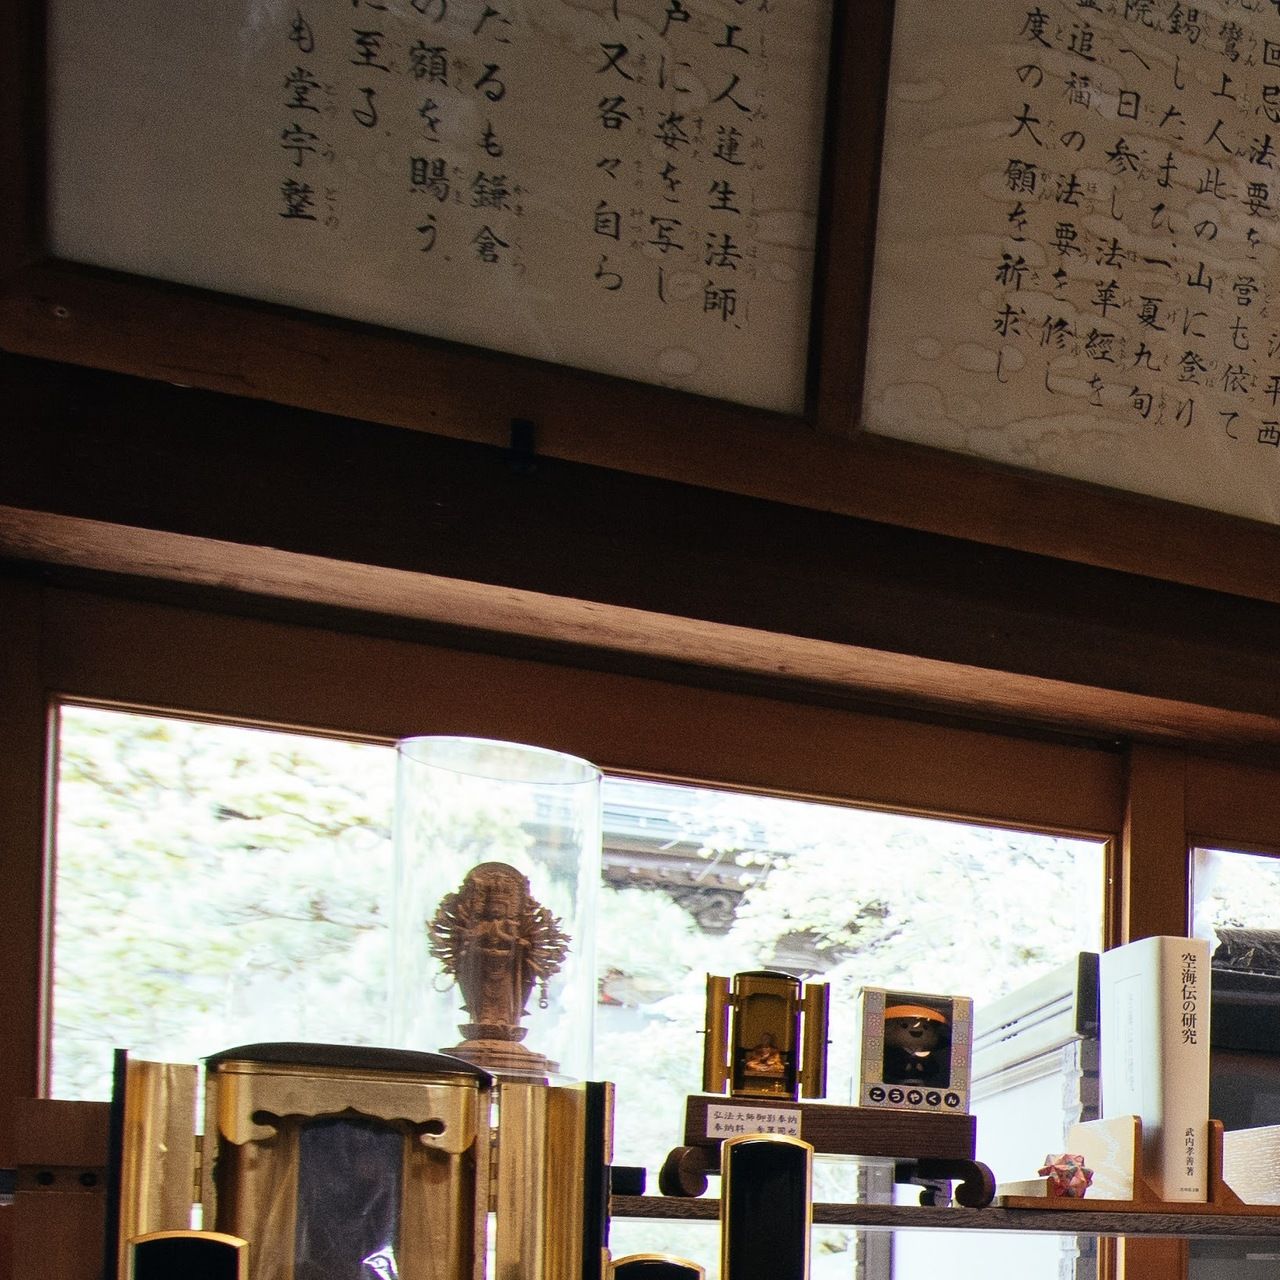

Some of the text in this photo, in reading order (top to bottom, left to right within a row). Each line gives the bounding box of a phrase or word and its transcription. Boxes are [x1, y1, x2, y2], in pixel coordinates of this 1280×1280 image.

[1181, 952, 1197, 1044] 空海伝の研究
[869, 1087, 960, 1107] こうやくん
